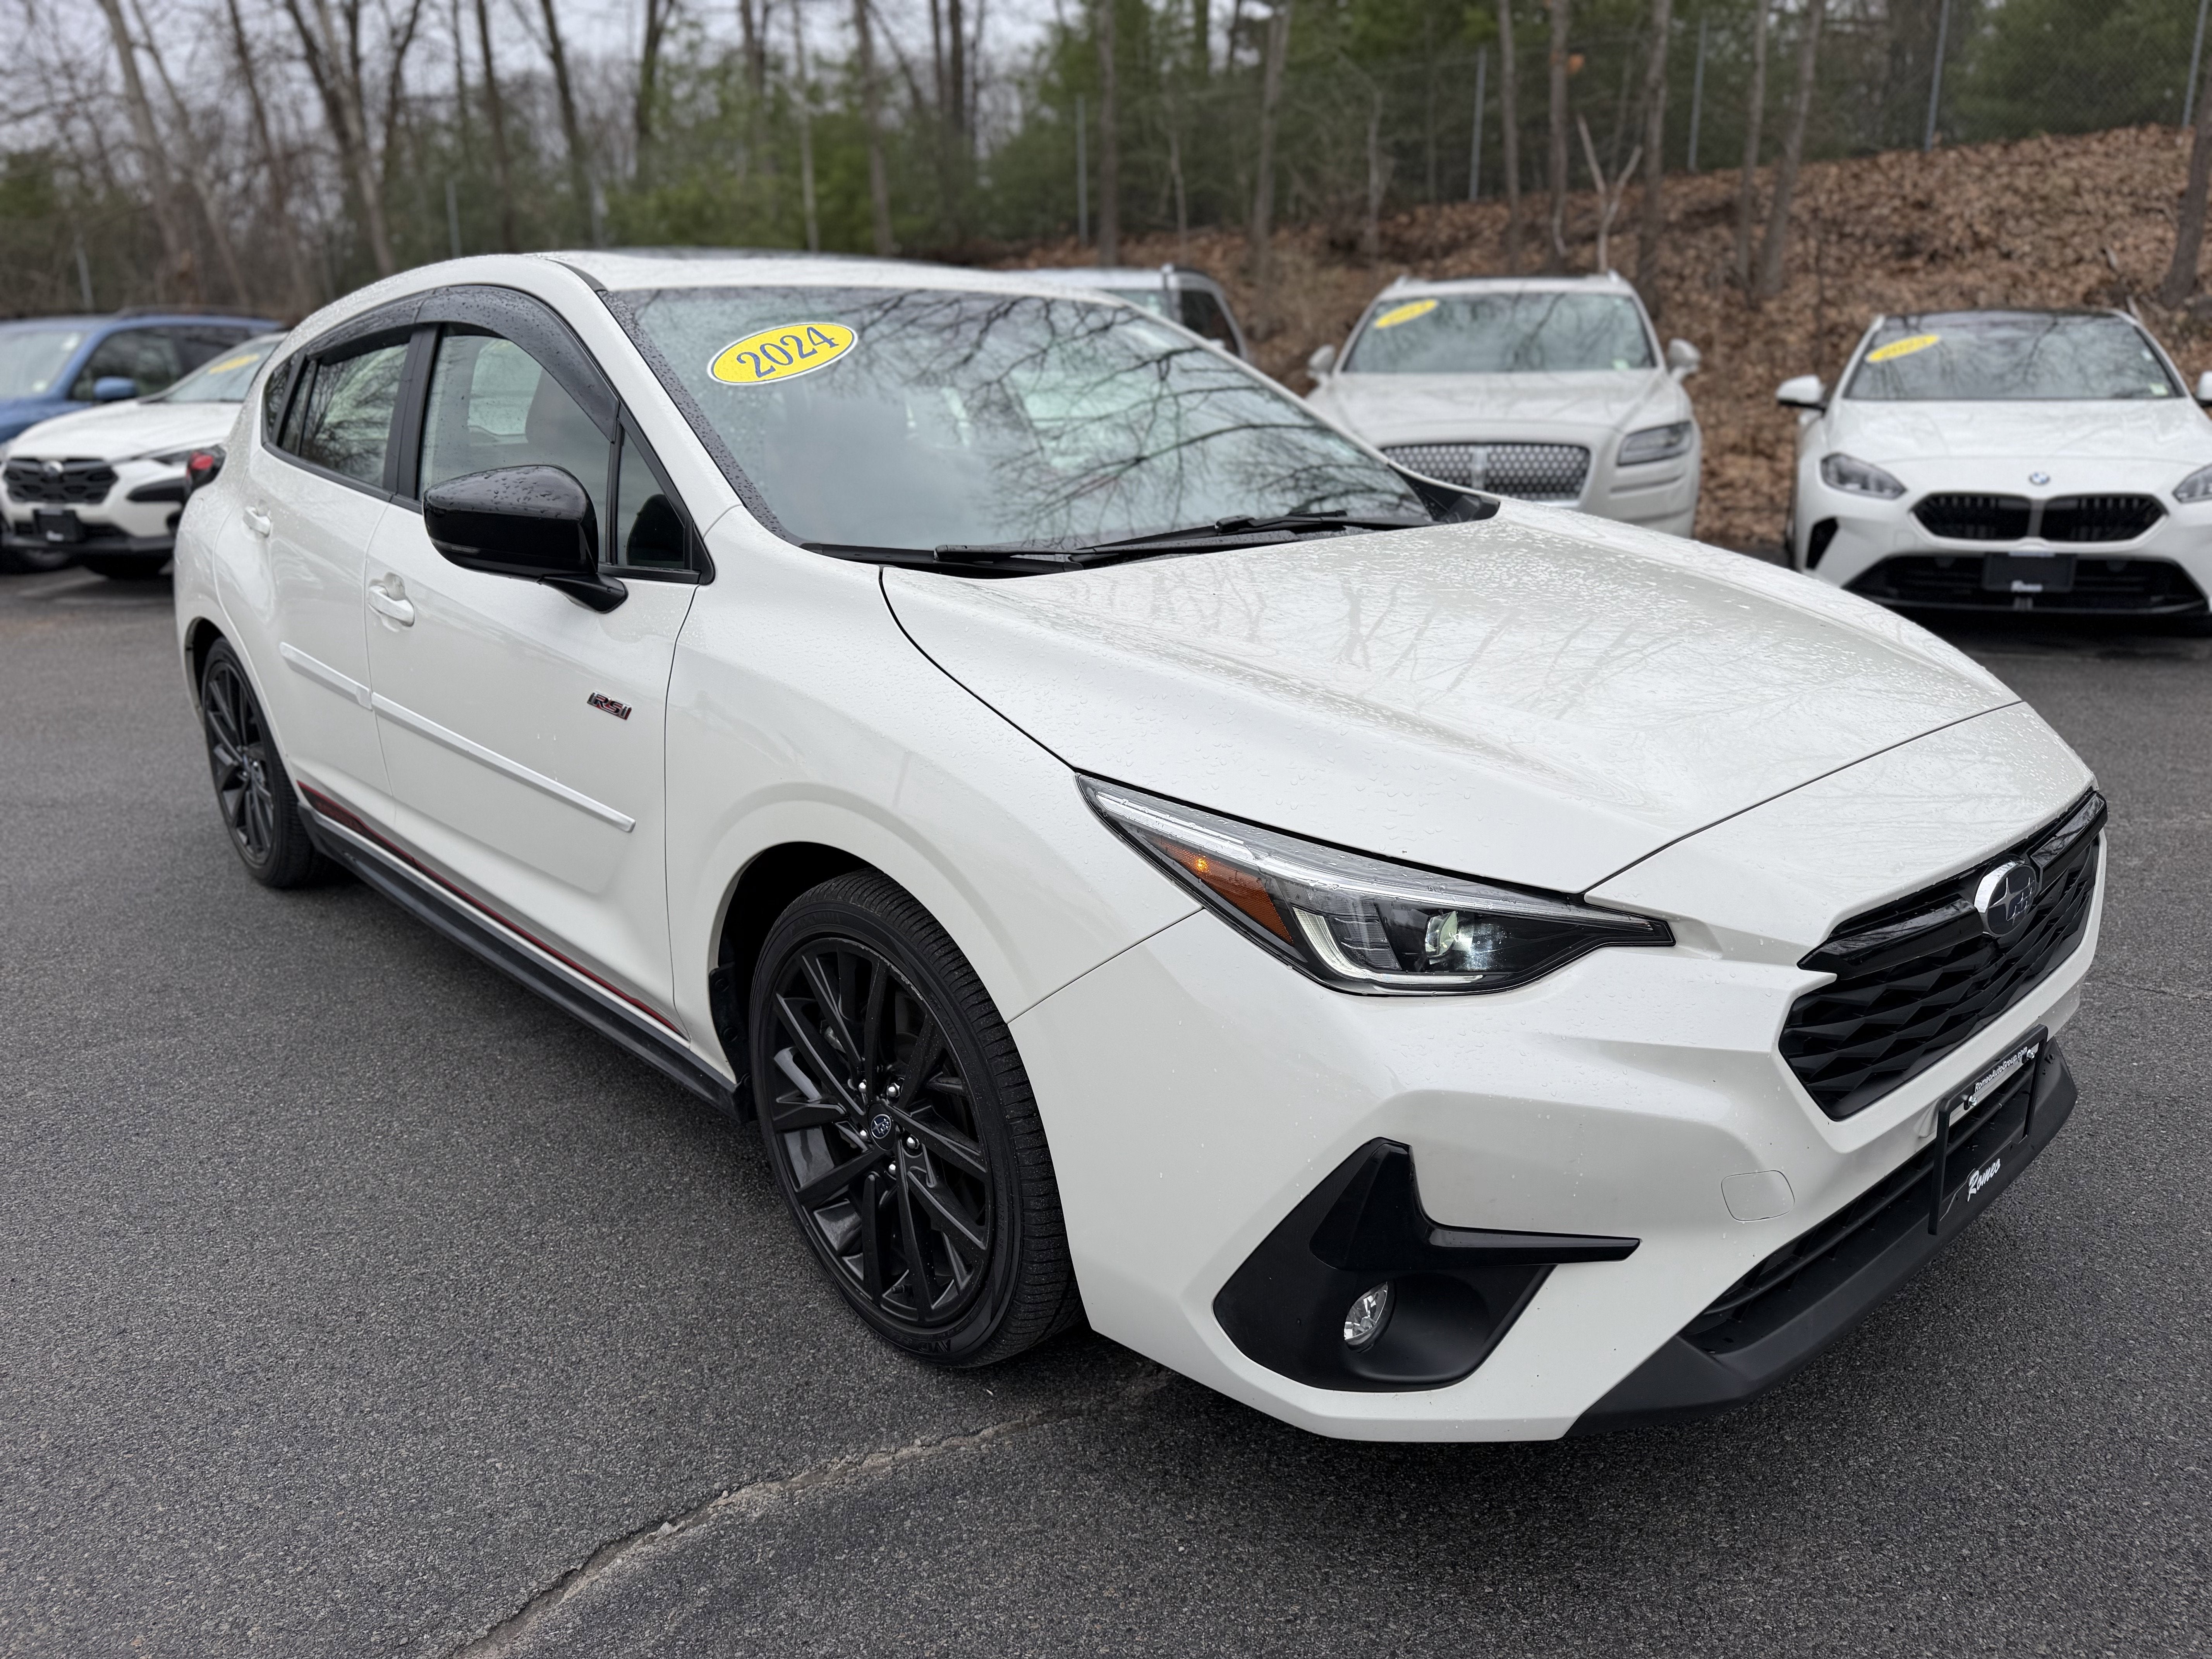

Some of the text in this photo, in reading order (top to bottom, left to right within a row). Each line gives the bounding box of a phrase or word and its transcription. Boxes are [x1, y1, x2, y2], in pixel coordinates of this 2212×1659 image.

[736, 326, 839, 378] 2024
[1975, 1046, 2028, 1092] RomeoAutoGroup.com
[1967, 1158, 2001, 1202] Romeo
